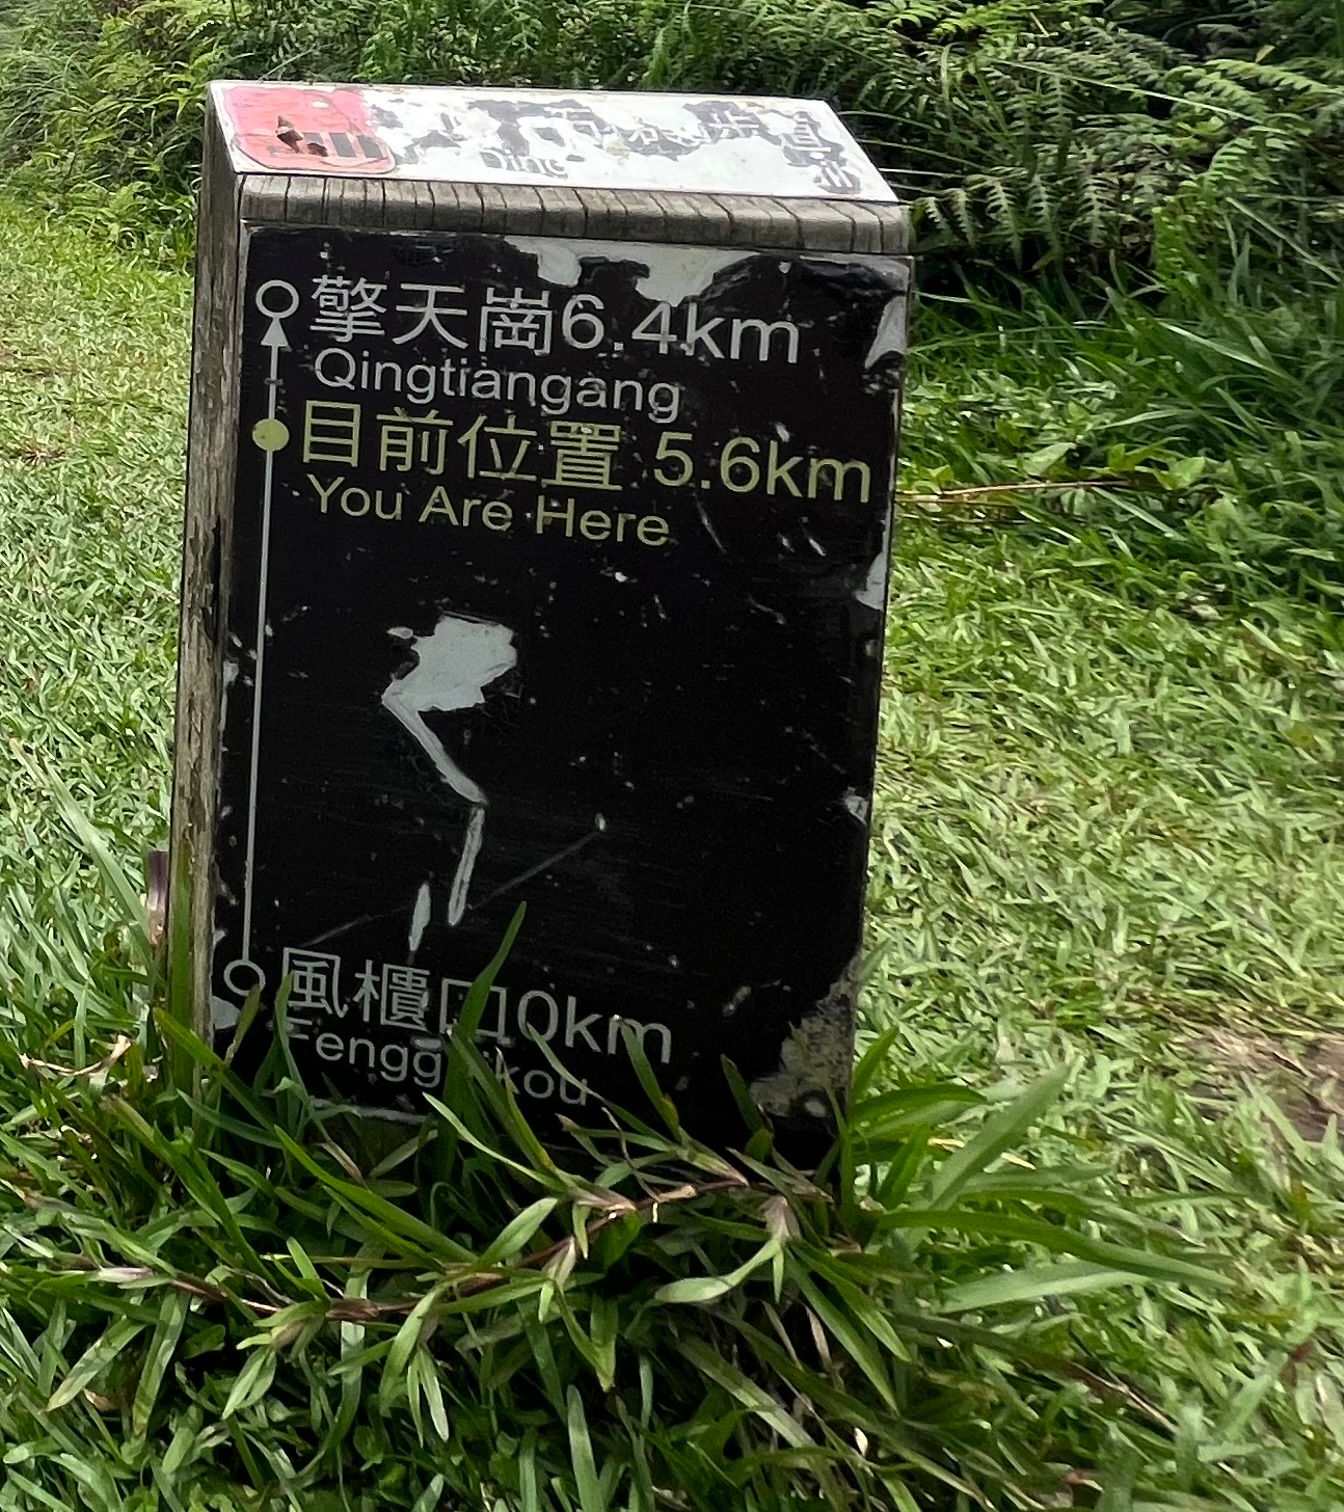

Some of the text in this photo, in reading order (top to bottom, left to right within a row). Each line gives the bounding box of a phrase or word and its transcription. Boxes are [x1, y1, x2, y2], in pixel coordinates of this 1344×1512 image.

[314, 346, 680, 425] Qingtiangang
[302, 399, 872, 504] 目前位置 5.6km
[306, 473, 671, 547] You Are Here
